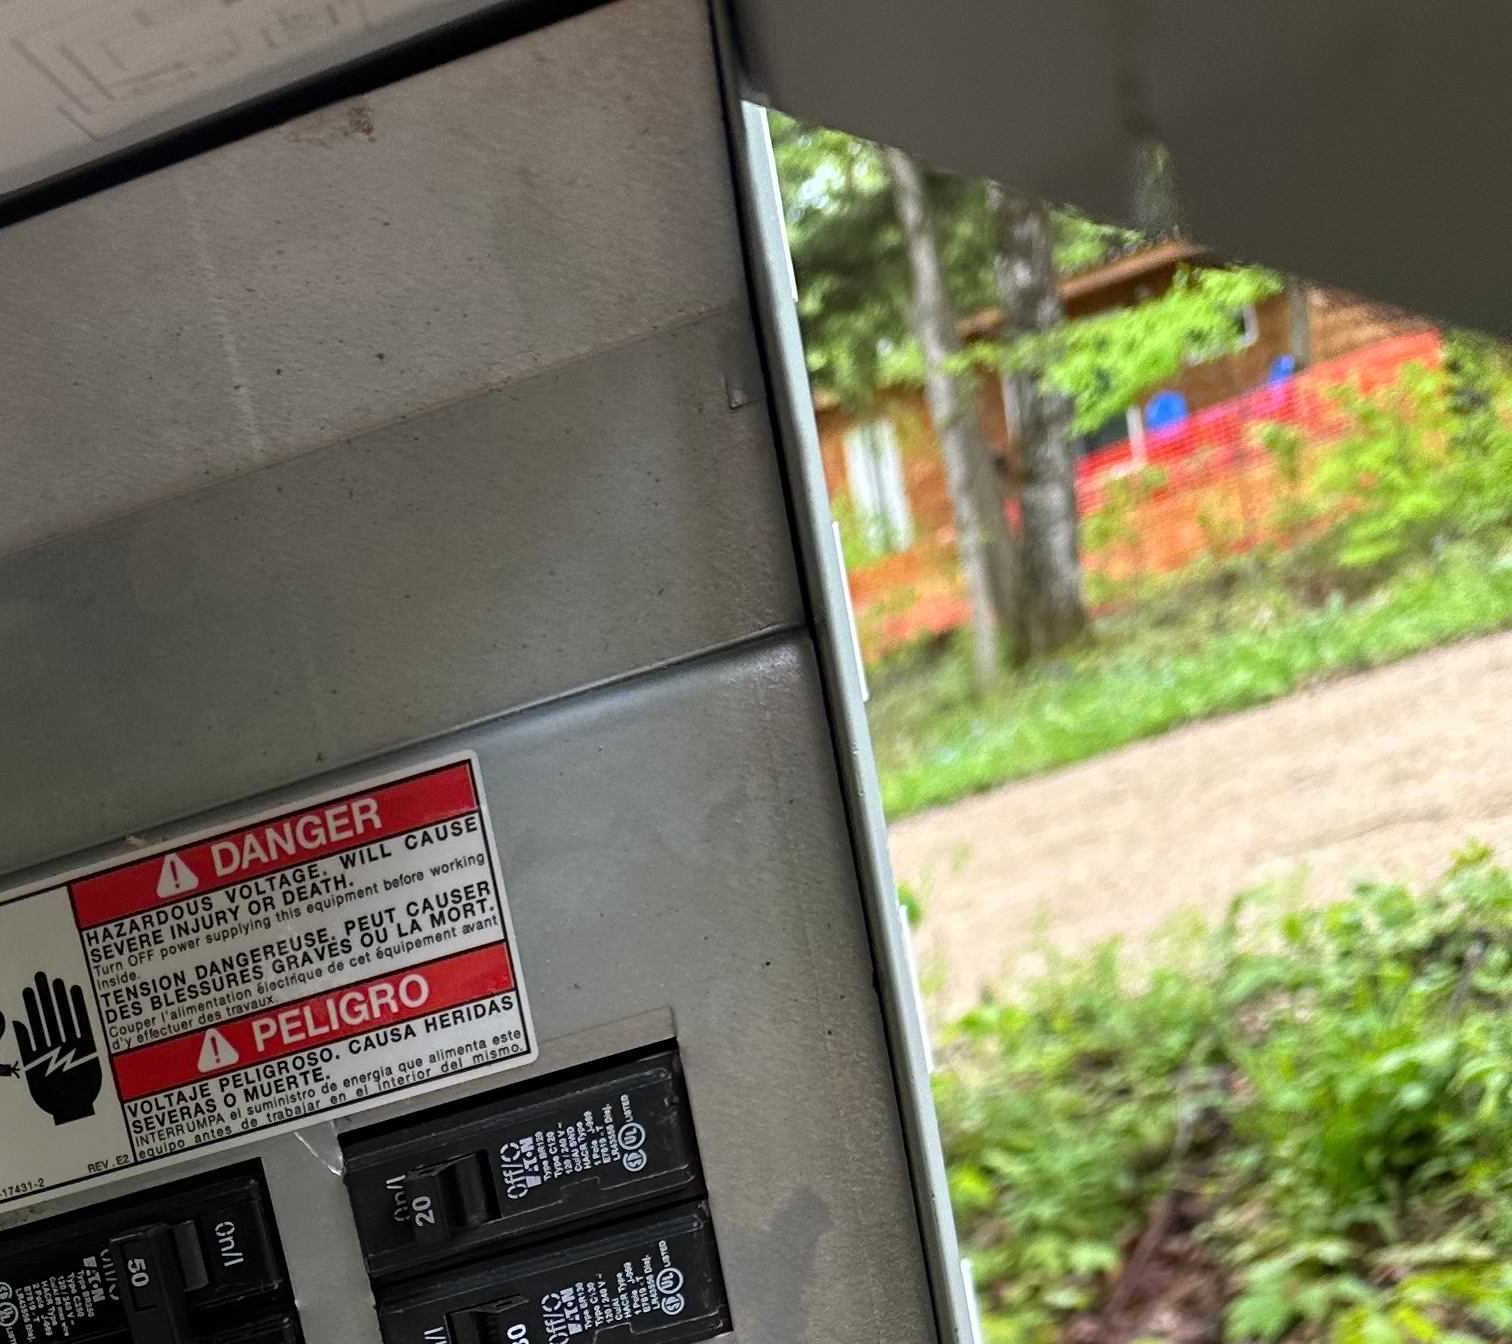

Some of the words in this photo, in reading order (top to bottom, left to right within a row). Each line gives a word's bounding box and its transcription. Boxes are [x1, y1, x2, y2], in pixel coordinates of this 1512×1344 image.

[210, 795, 383, 877] DANGER
[85, 894, 214, 947] HAZARDOUS
[224, 860, 327, 905] VOLTAGE.
[338, 841, 392, 871] WILL
[403, 815, 478, 851] CAUSE
[88, 928, 165, 964] SEVERE
[169, 904, 242, 940] INJURY
[246, 894, 276, 917] OR
[281, 871, 354, 906] DEATH.
[93, 958, 124, 978] Turn
[126, 948, 156, 968] OFF
[159, 937, 202, 960] power
[204, 913, 272, 947] supplying
[273, 904, 302, 924] this
[304, 881, 380, 916] equipment
[382, 867, 425, 891] before
[429, 849, 486, 880] working
[95, 966, 141, 991] inside.
[100, 969, 187, 1009] TENSION
[193, 925, 336, 981] DANGEREUSE.
[343, 906, 398, 937] PEUT
[404, 879, 491, 919] CAUSER
[104, 999, 144, 1025] DES
[148, 963, 265, 1012] BLESSURES
[270, 937, 353, 976] GRAVES
[358, 926, 390, 950] OU
[395, 917, 422, 939] LA
[428, 895, 495, 929] MORT.
[108, 1013, 158, 1040] Couper
[160, 985, 252, 1024] l'alimentation
[255, 963, 324, 997] électrique
[326, 958, 345, 974] de
[347, 951, 372, 968] cet
[374, 924, 458, 962] équipement
[460, 914, 499, 935] avant
[110, 1034, 134, 1053] d'y
[135, 1016, 195, 1044] effectuer
[196, 1008, 222, 1026] des
[224, 991, 279, 1018] travaux.
[250, 969, 432, 1053] PELIGRO
[126, 1081, 212, 1119] VOLTAJE
[217, 1044, 341, 1093] PELIGROSO.
[347, 1022, 417, 1056] CAUSA
[423, 993, 514, 1034] HERIDAS
[134, 1111, 226, 1148] INTERRUMPA
[228, 1106, 242, 1121] el
[245, 1085, 316, 1116] suministro
[319, 1079, 338, 1095] de
[396, 1056, 424, 1075] que
[427, 1036, 487, 1064] alimenta
[490, 1026, 522, 1046] este
[130, 1097, 217, 1135] SEVERAS
[221, 1091, 238, 1109] O
[242, 1064, 331, 1103] MUERTE.
[137, 1136, 187, 1162] equipo
[192, 1123, 233, 1144] antes
[239, 1115, 258, 1131] de
[265, 1097, 322, 1124] trabajar
[329, 1092, 347, 1106] en
[354, 1083, 369, 1098] el
[375, 1065, 433, 1092] interior
[438, 1056, 464, 1074] del
[471, 1040, 524, 1065] mismo.
[544, 1129, 558, 1155] C120
[549, 1153, 565, 1179] Type
[214, 1220, 245, 1268] On/I
[413, 1194, 436, 1226] 20
[126, 1257, 147, 1288] 50
